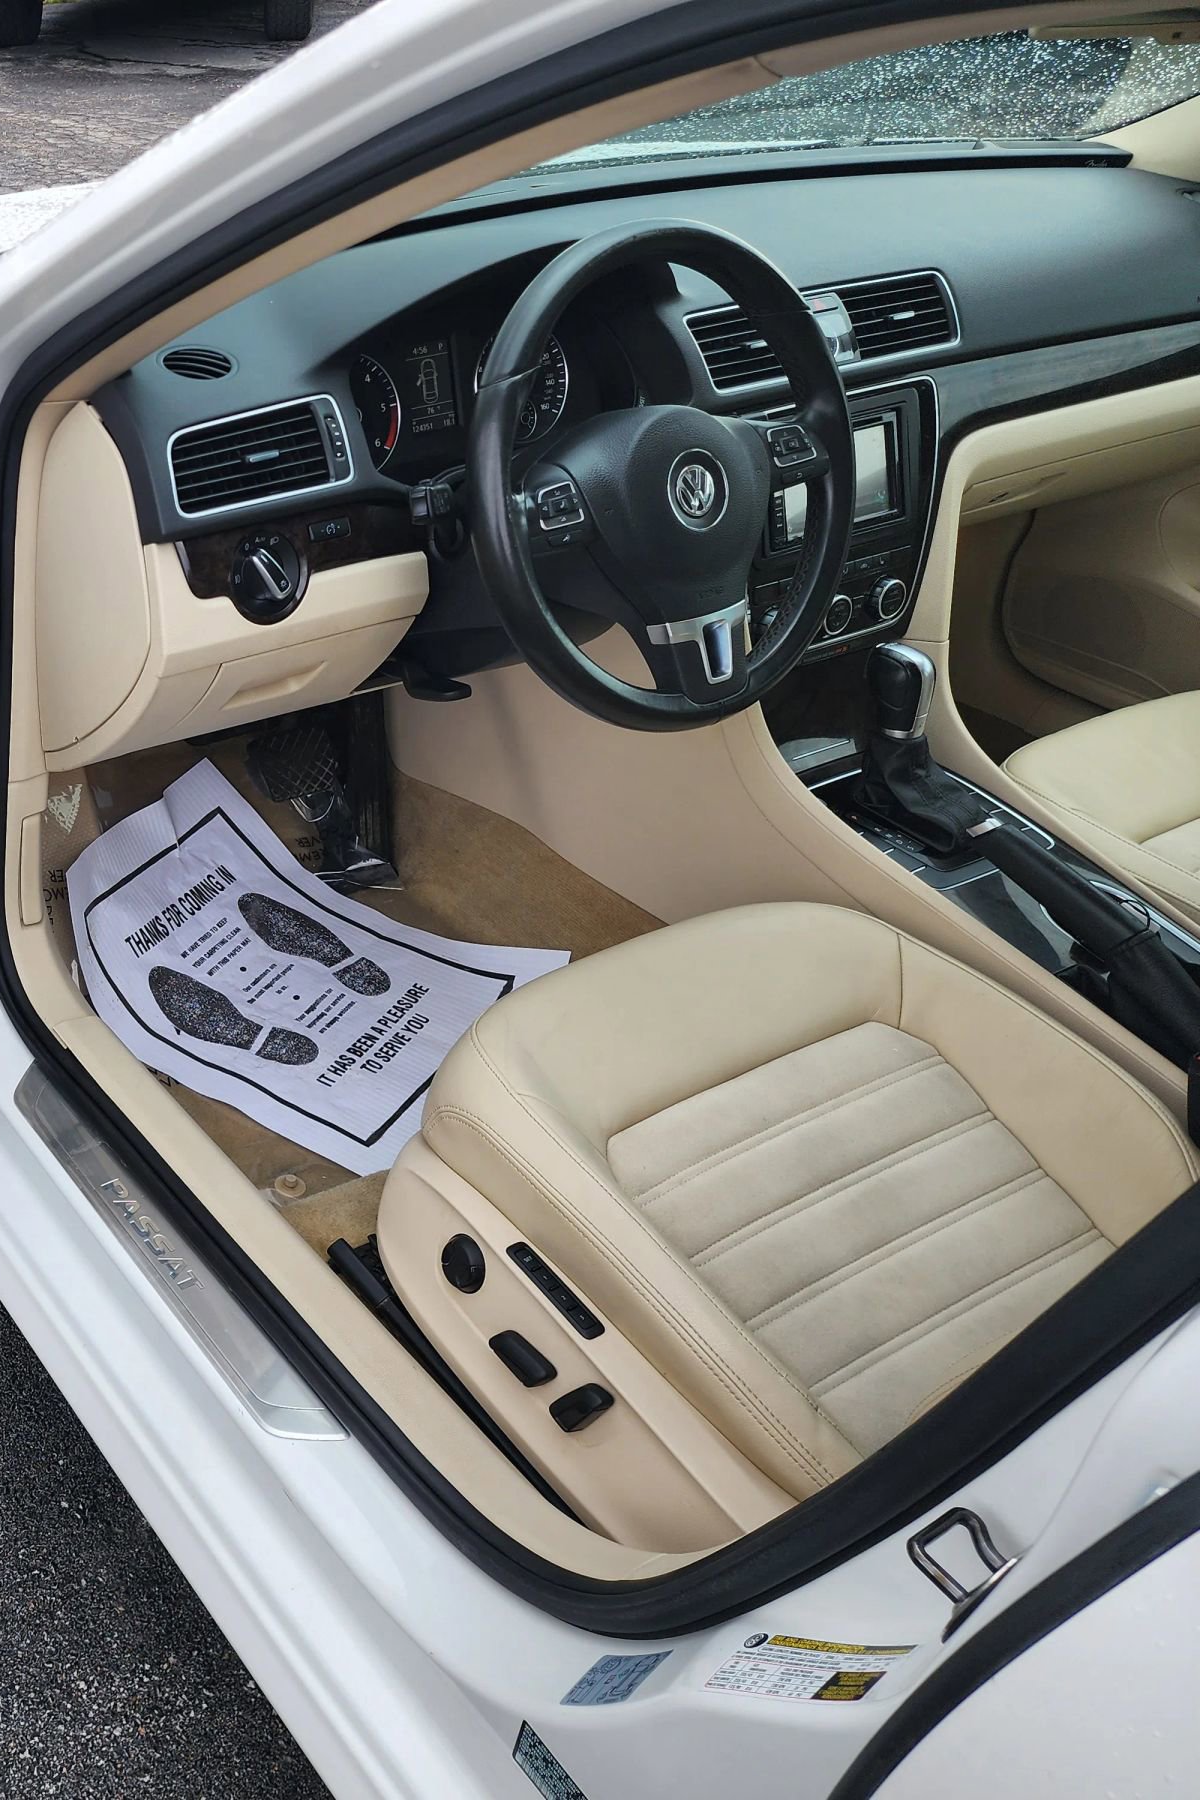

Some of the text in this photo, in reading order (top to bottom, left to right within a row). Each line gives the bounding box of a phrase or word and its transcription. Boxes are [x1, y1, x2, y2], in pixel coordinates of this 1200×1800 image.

[364, 374, 371, 383] 4
[380, 403, 387, 412] 5
[374, 439, 382, 448] 6
[125, 864, 237, 958] THANKS FOR COMING IN
[180, 917, 228, 959] WE HAVE TRIED TO KEEP
[192, 926, 242, 969] YOUR CARPETING CLEAN
[206, 937, 252, 977] WITH THIS PAPER MAT
[316, 982, 430, 1087] IT HAS BEEN A PLEASURE
[360, 1013, 430, 1074] TO SERVE YOU
[100, 1178, 206, 1290] PASSAT
